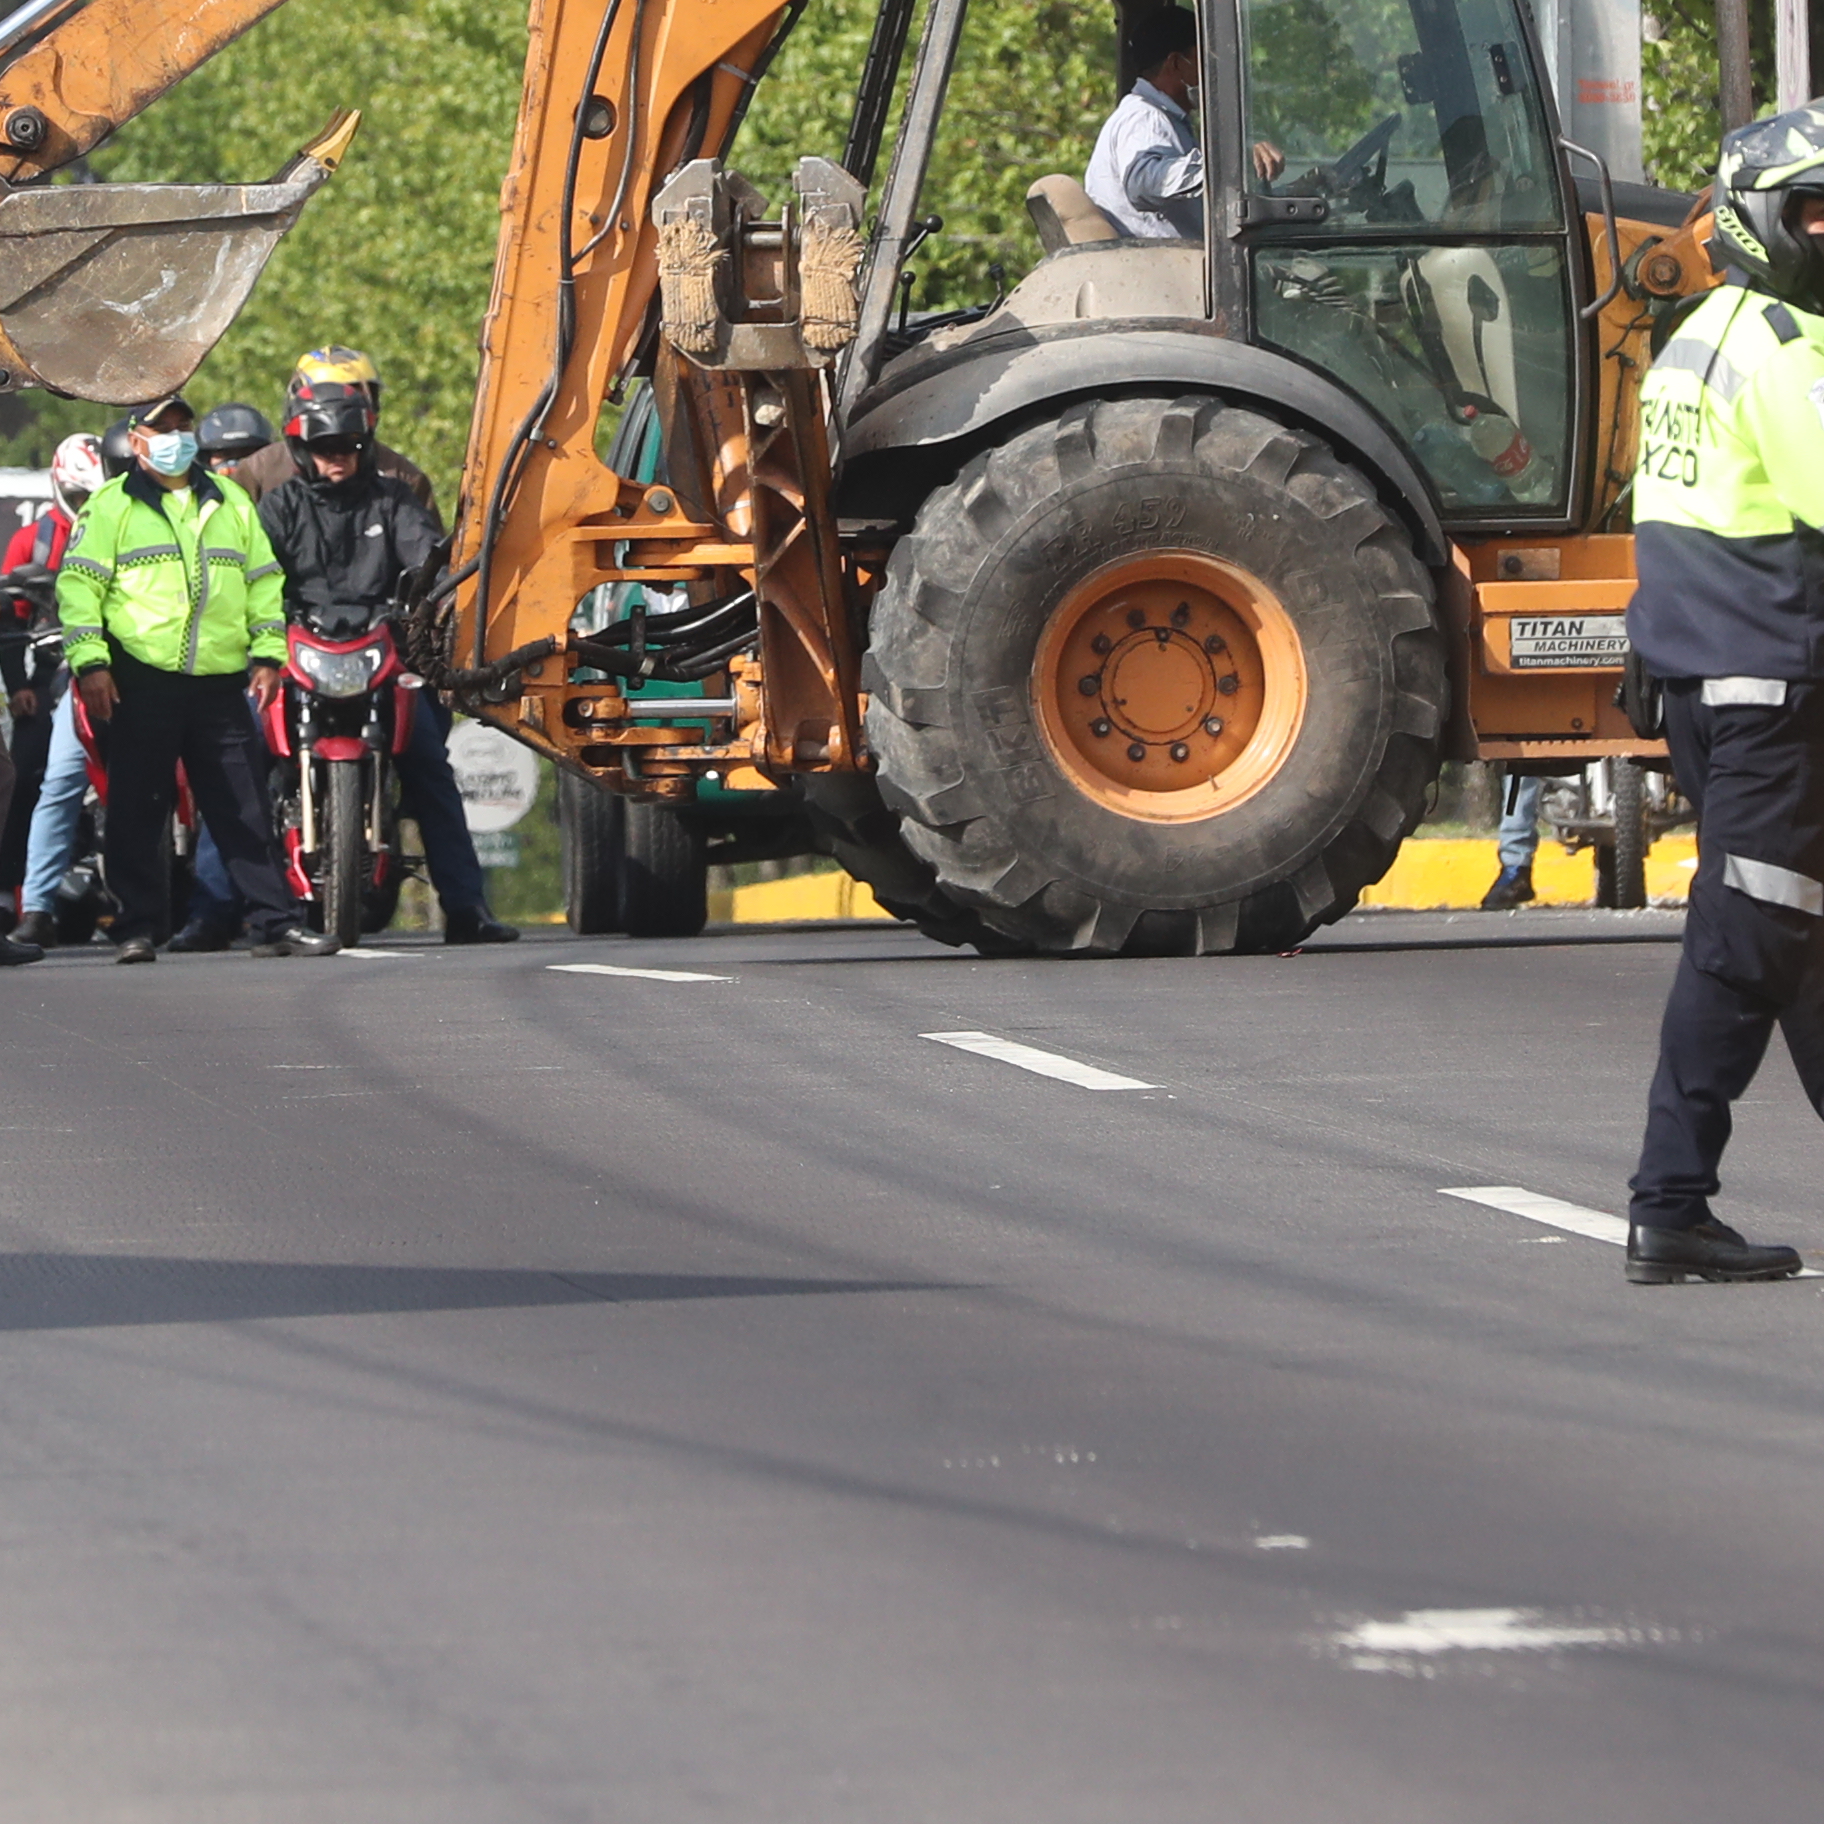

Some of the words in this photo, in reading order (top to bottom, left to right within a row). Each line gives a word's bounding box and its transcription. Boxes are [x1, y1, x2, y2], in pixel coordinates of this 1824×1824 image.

[1111, 495, 1187, 535] 459
[1516, 620, 1585, 637] TITAN
[1533, 639, 1627, 653] MACHINERY
